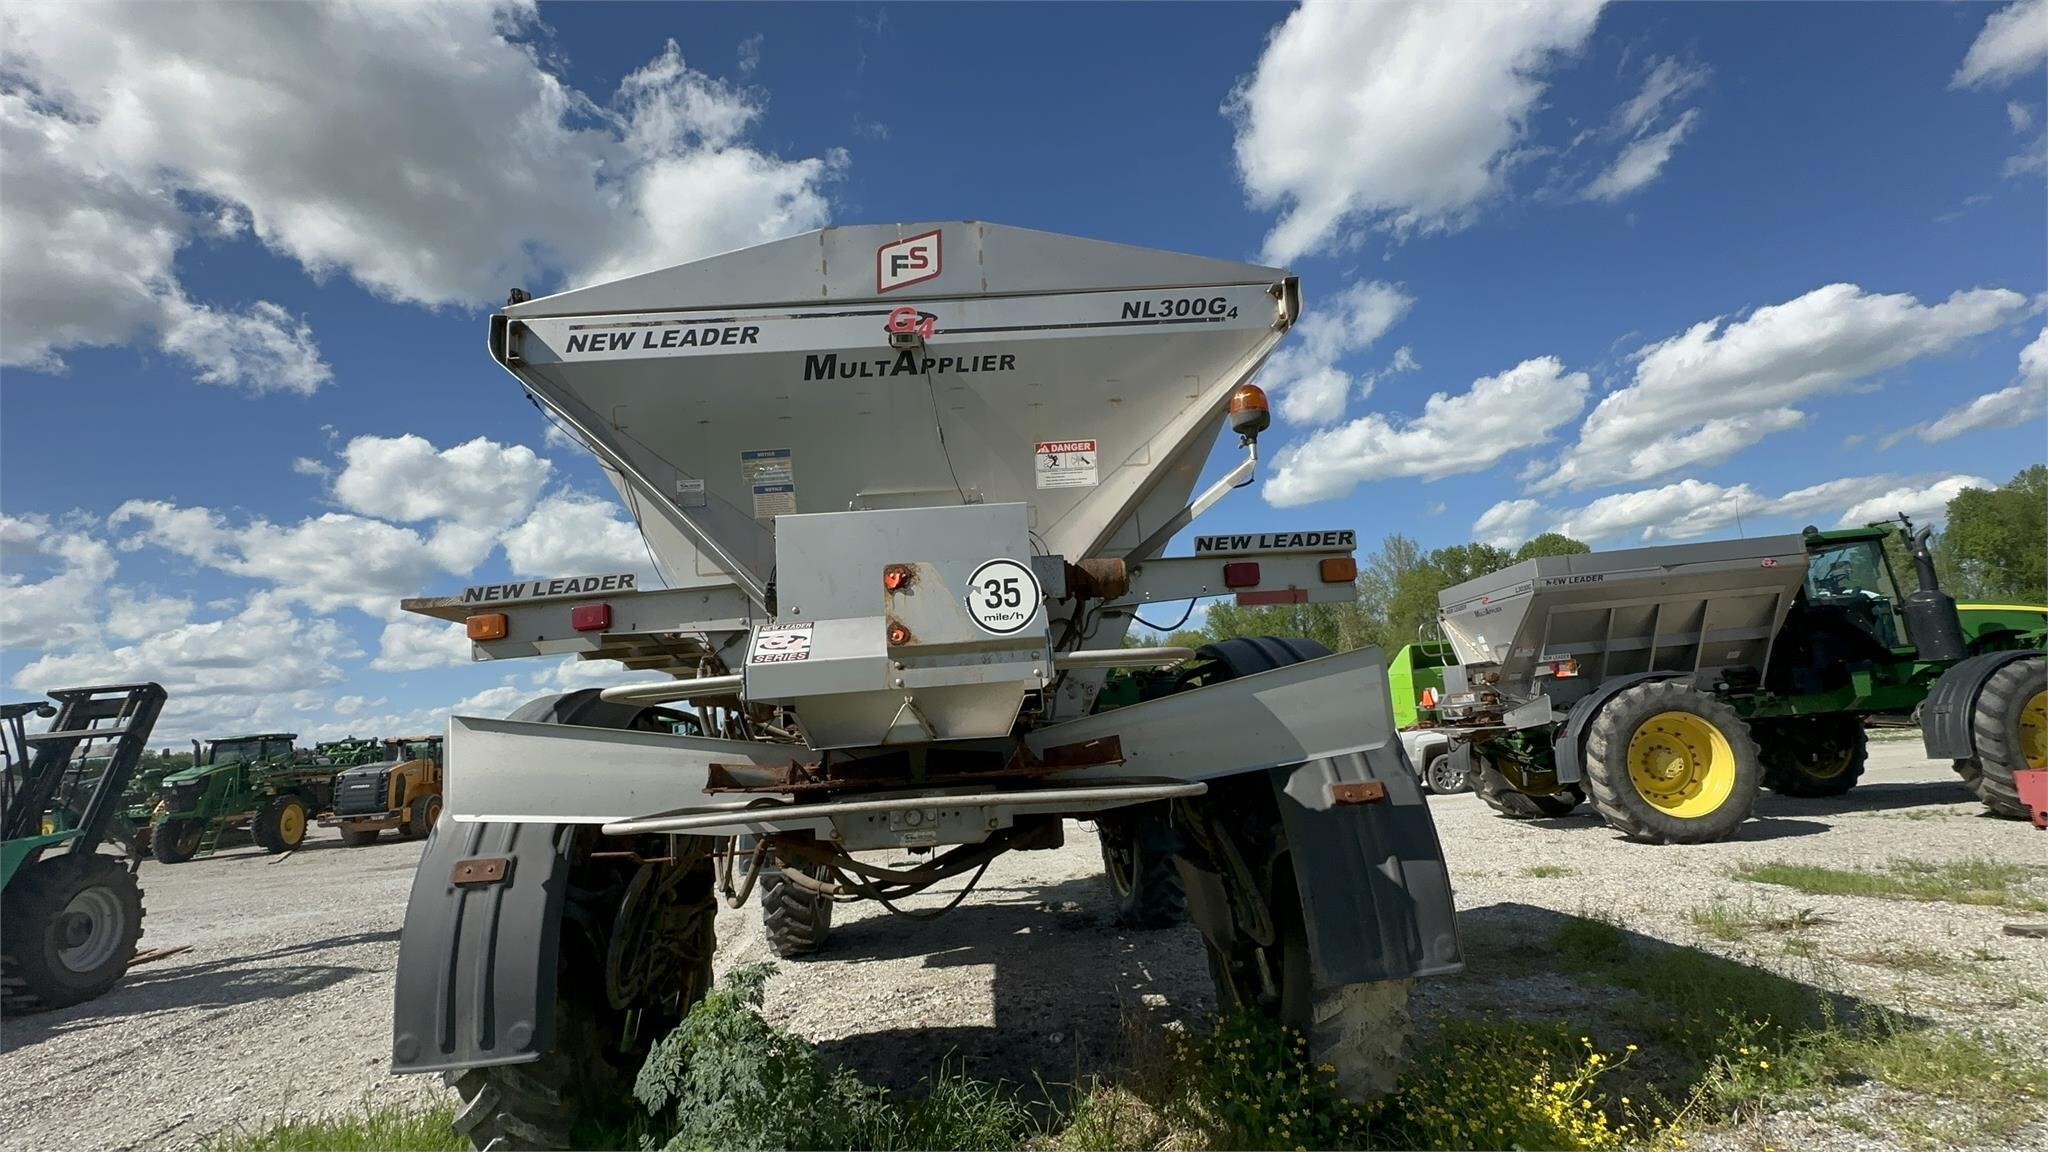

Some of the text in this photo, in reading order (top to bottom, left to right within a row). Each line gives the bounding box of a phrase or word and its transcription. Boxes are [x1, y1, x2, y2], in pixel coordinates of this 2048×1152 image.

[891, 246, 929, 277] FS
[1121, 297, 1239, 320] NL300G4
[565, 326, 761, 353] NEW LEADER
[1051, 443, 1091, 452] DANGER
[1196, 531, 1354, 551] NEW LEADER
[465, 573, 636, 602] NEW LEADER
[1568, 574, 1604, 584] LEADER
[984, 578, 1021, 609] 35
[984, 612, 1024, 622] mile/h
[761, 623, 812, 632] NEW LEADER
[755, 652, 806, 662] SERIES
